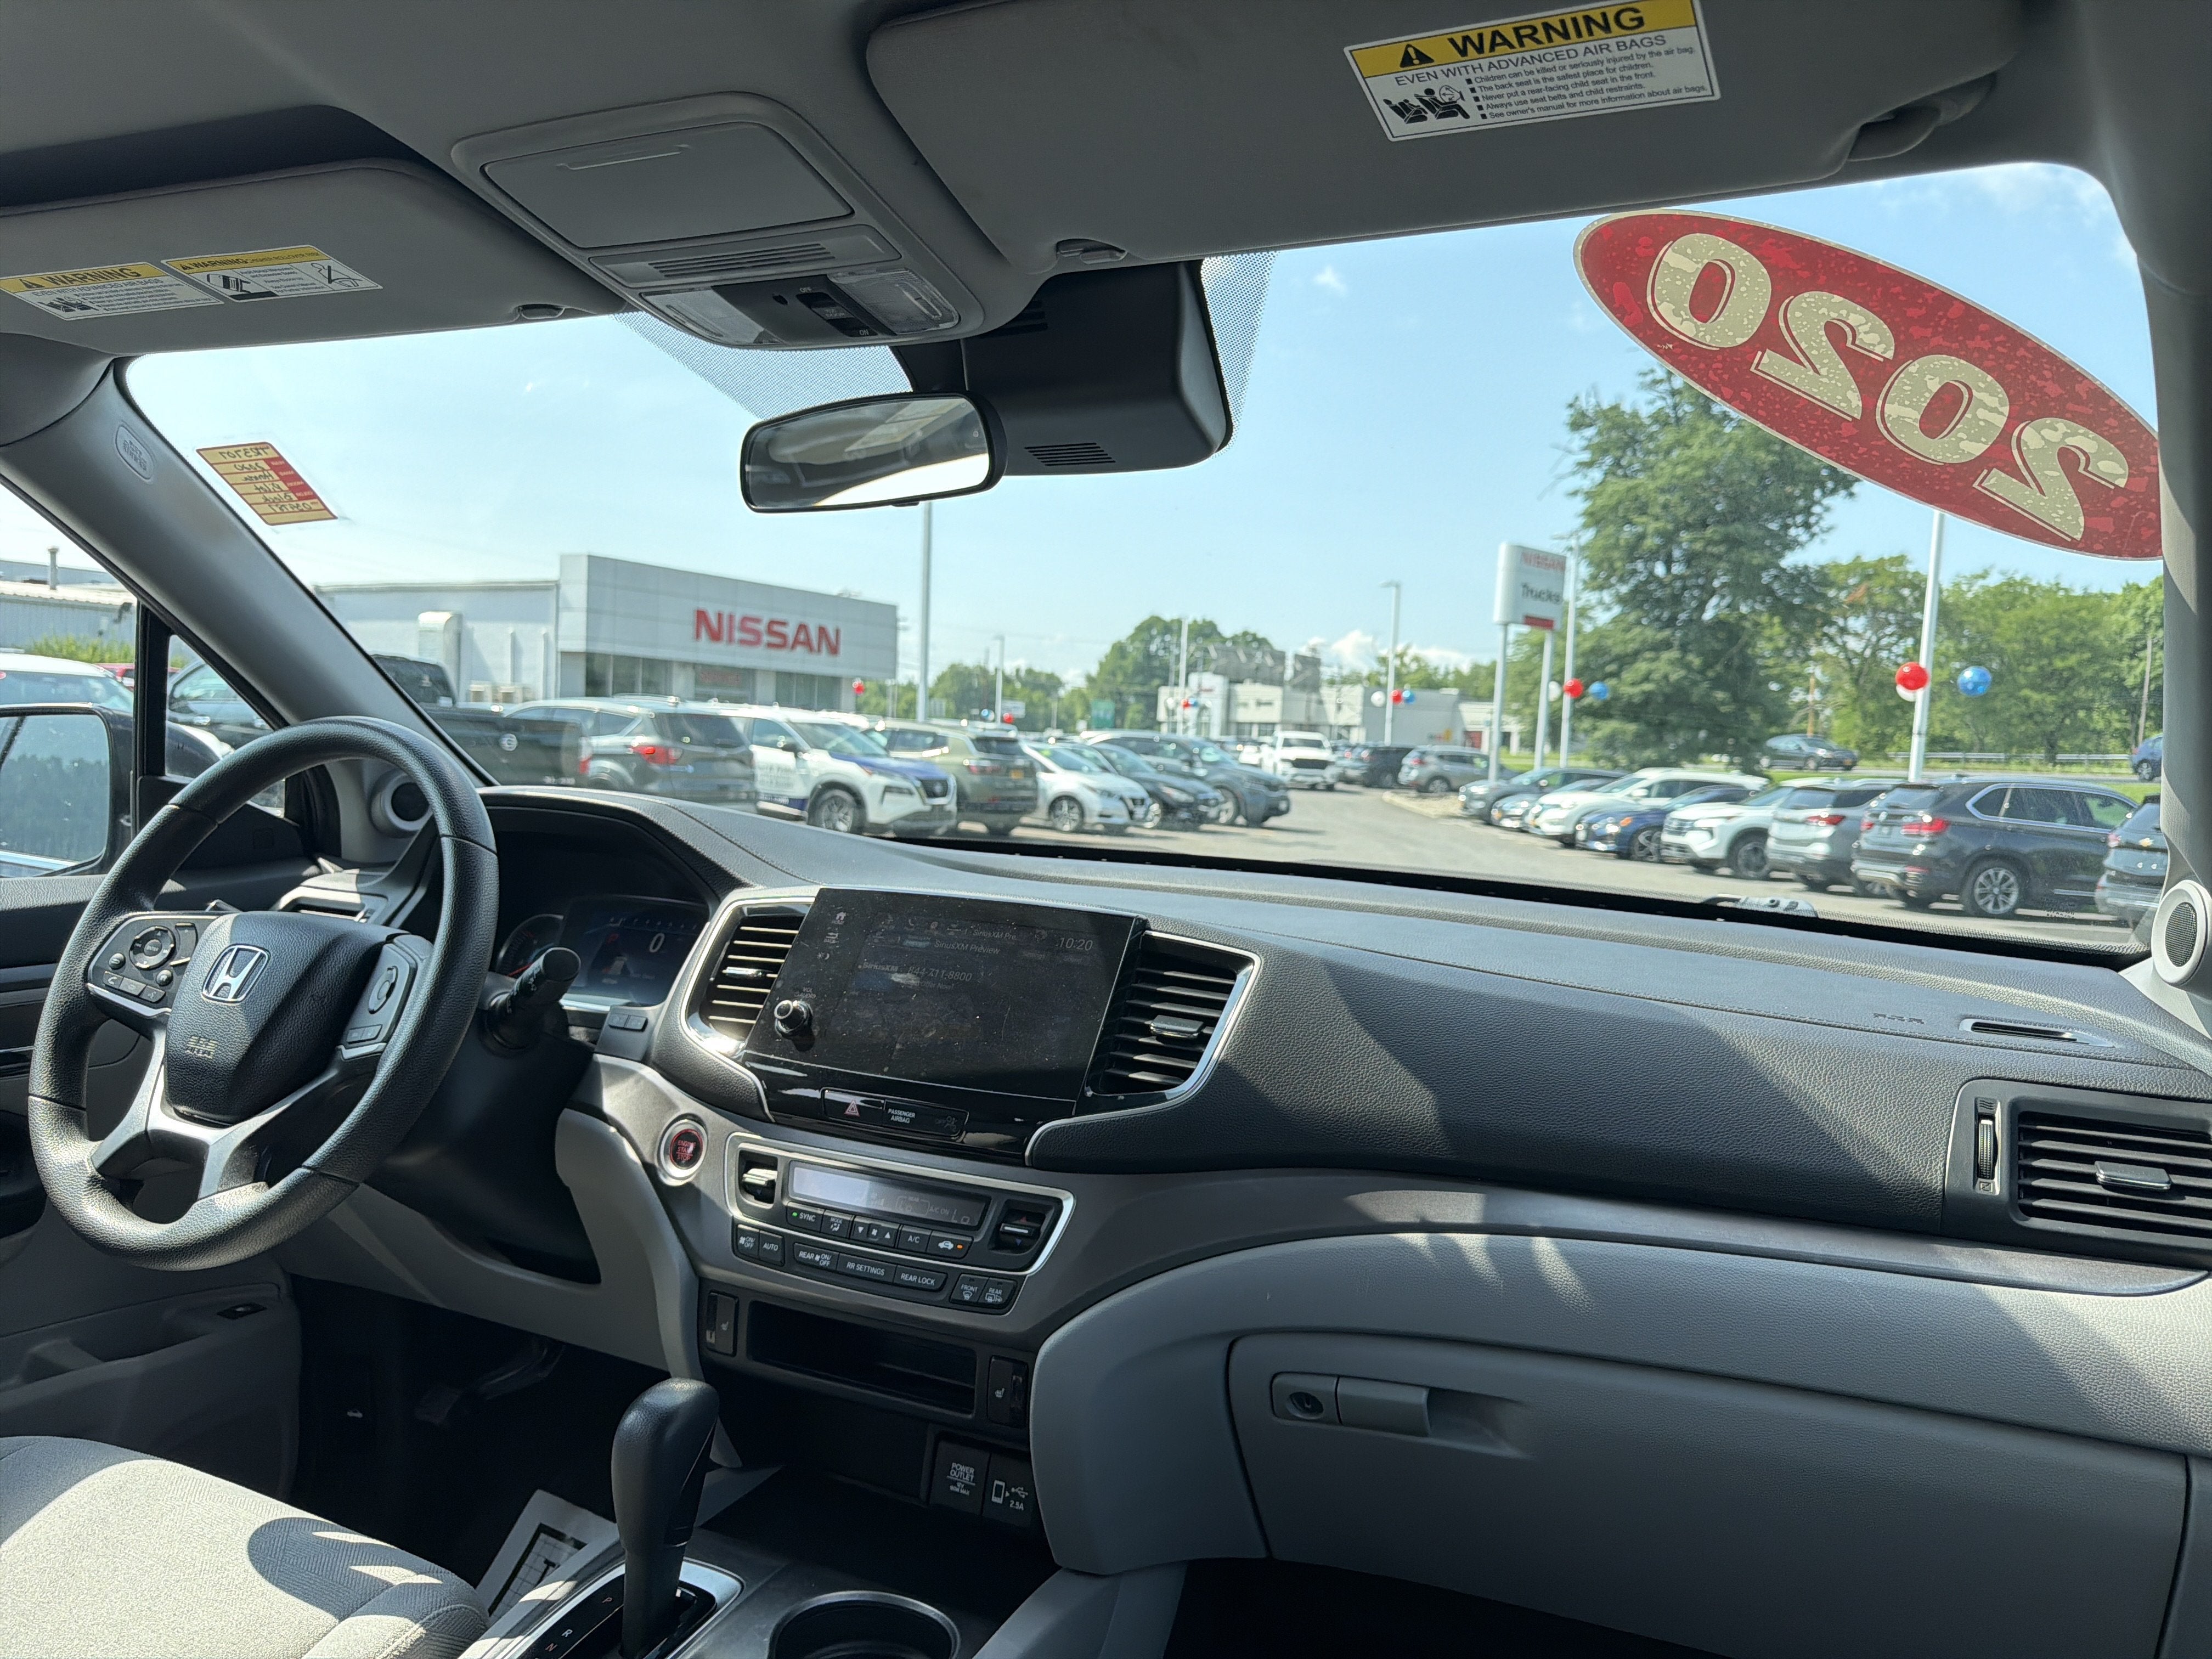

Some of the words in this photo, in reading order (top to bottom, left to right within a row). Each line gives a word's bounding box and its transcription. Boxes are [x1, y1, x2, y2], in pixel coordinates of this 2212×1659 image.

[1447, 6, 1645, 58] WARNING
[1395, 71, 1438, 86] EVEN
[1441, 63, 1485, 78] WITH
[1485, 48, 1579, 71] ADVANCED
[1580, 42, 1615, 57] AIR
[1616, 34, 1667, 52] BAGS
[1474, 72, 1507, 83] Children
[1535, 65, 1556, 74] killed
[1567, 58, 1605, 71] seriously
[1605, 53, 1634, 65] injured
[1635, 52, 1646, 61] by
[1647, 49, 1662, 58] the
[1663, 47, 1675, 55] air
[1494, 81, 1514, 89] back
[1514, 79, 1533, 87] seat
[1555, 71, 1581, 81] safest
[1581, 68, 1605, 78] place
[1481, 92, 1505, 101] Never
[1506, 91, 1520, 99] put
[1526, 83, 1570, 96] rear-facing
[1570, 80, 1589, 88] child
[1590, 77, 1609, 86] seat
[1618, 74, 1633, 82] the
[1484, 100, 1513, 111] Always
[1547, 93, 1567, 101] belts
[1584, 88, 1604, 96] child
[1505, 106, 1535, 116] owner's
[1536, 103, 1565, 112] manual
[1600, 92, 1645, 103] information
[1646, 88, 1671, 97] about
[190, 258, 249, 268] WARNING:
[41, 268, 141, 286] WARNING
[77, 283, 122, 292] ADVANCED
[1521, 582, 1562, 604] Trucks
[694, 608, 843, 657] NISSAN
[649, 932, 665, 953] 0
[934, 940, 968, 951] SiriusXM
[969, 944, 1001, 955] Preview
[1058, 937, 1093, 951] 10:20
[888, 1108, 916, 1118] PASSENGER
[890, 1115, 910, 1124] AIRBAG
[799, 1212, 816, 1222] SYNC
[907, 1235, 920, 1244] A/C
[763, 1242, 778, 1252] AUTO
[799, 1250, 814, 1260] REAR
[821, 1253, 832, 1261] ON/
[819, 1259, 830, 1267] OFF
[856, 1263, 885, 1276] SETTINGS
[901, 1273, 918, 1283] REAR
[918, 1276, 935, 1286] LOCK
[961, 1284, 978, 1293] FRONT
[951, 1463, 975, 1475] POWER
[950, 1470, 975, 1482] OUTLET
[1009, 1500, 1024, 1511] 2.5A
[561, 1629, 573, 1638] R
[545, 1643, 558, 1652] N
